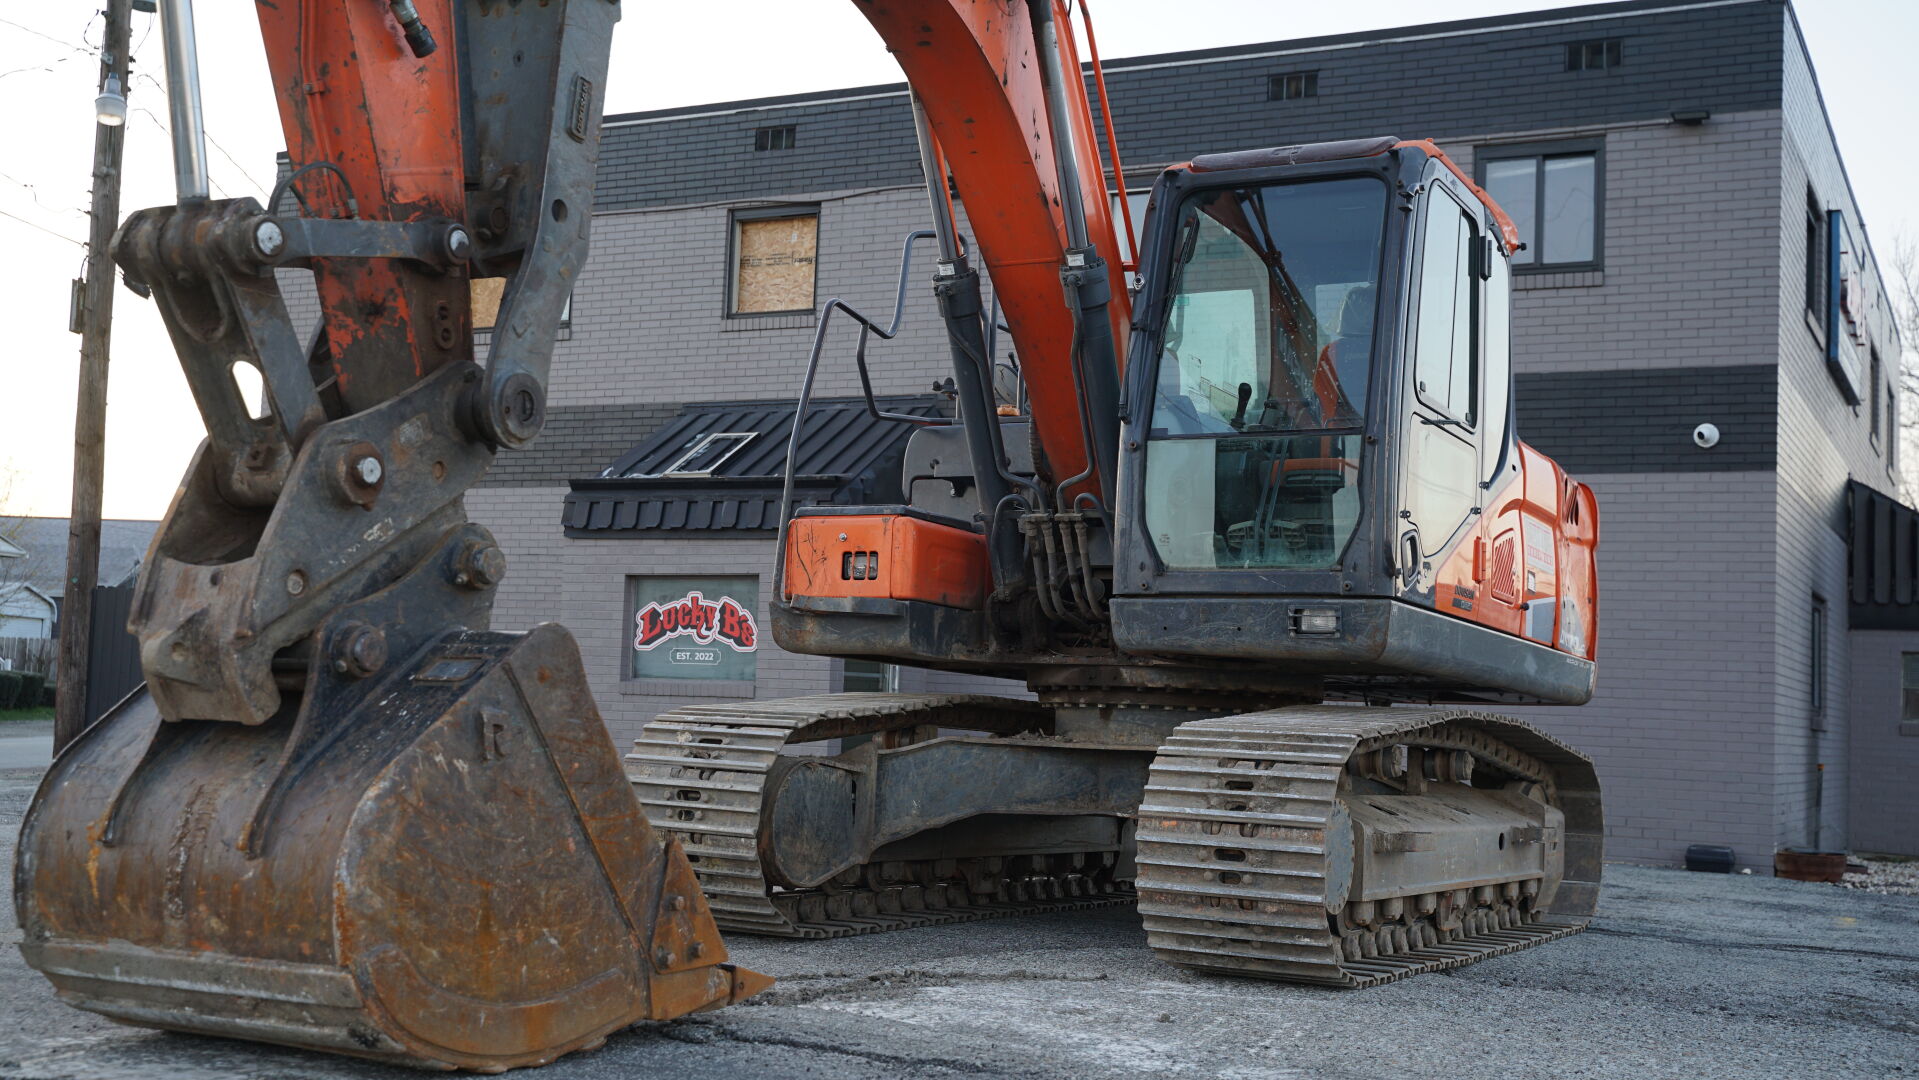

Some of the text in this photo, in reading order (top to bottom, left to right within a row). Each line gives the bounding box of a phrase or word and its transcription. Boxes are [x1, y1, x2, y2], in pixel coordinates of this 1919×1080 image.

[718, 602, 755, 647] B's
[676, 651, 714, 661] EST. 2022
